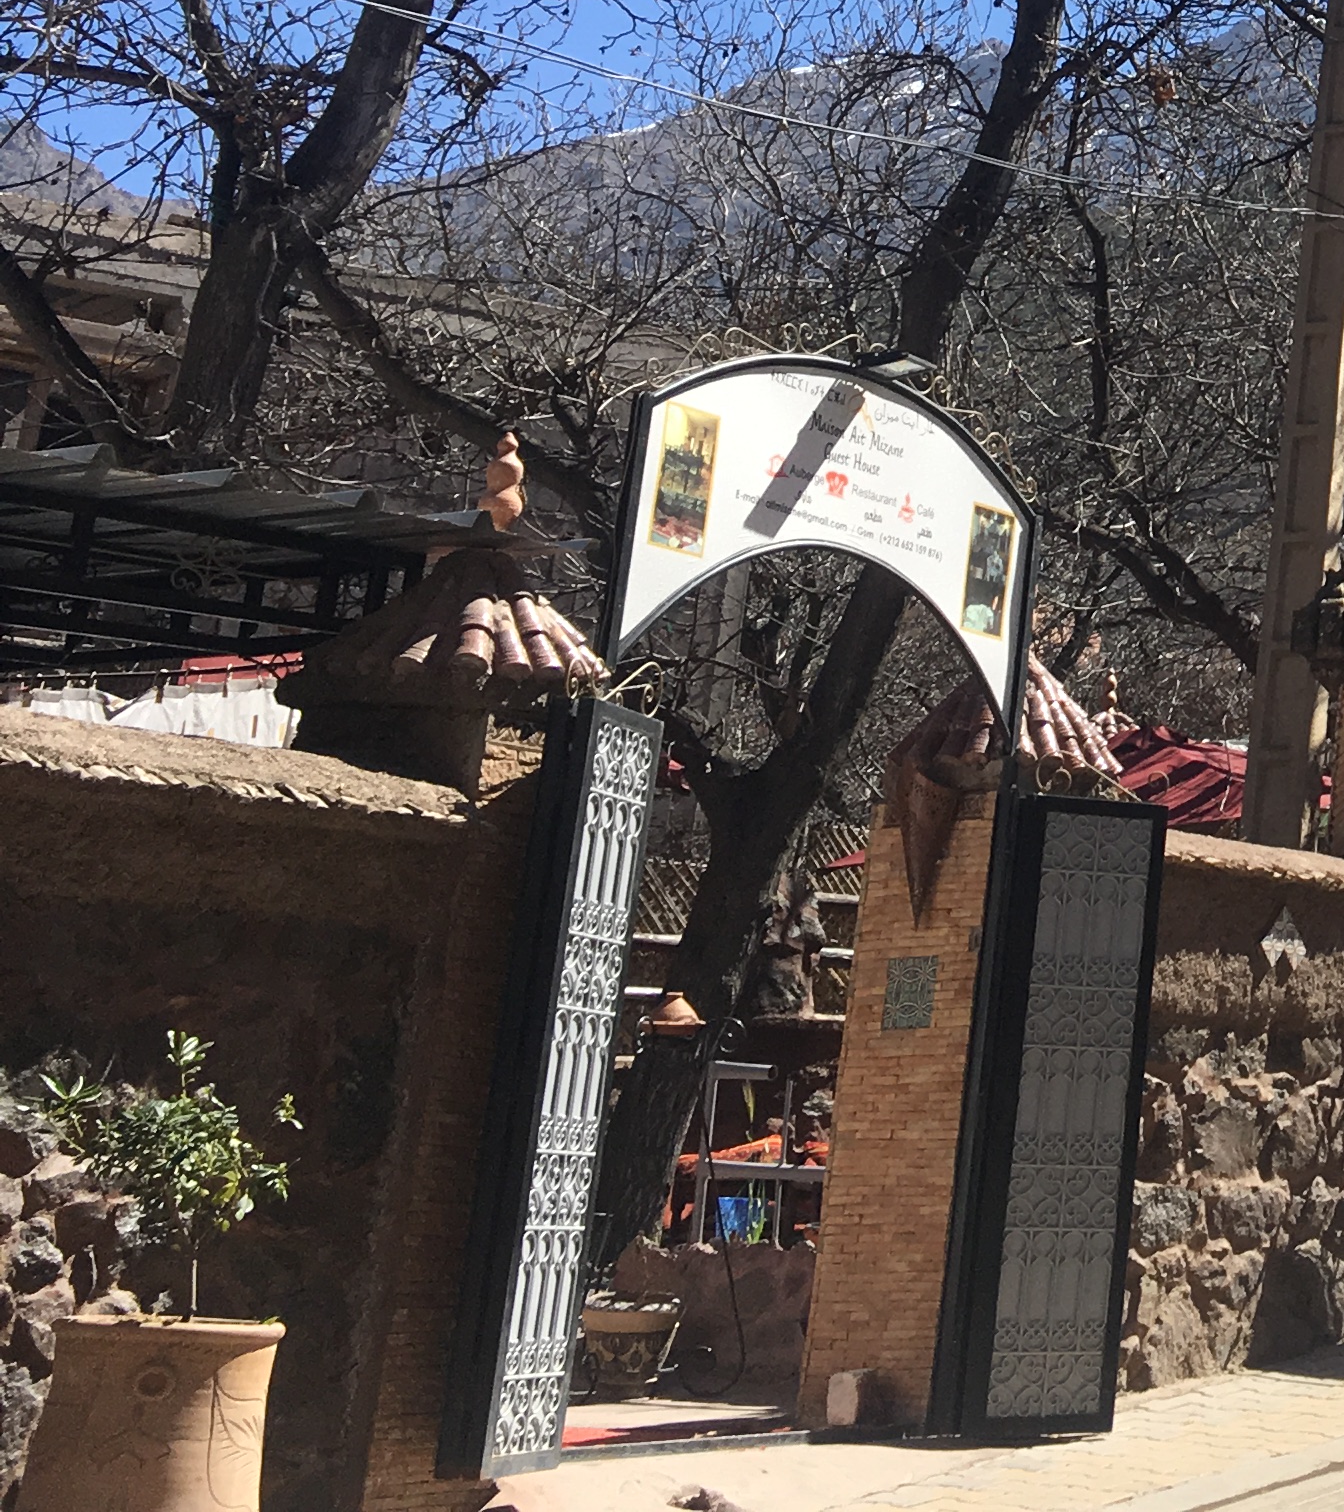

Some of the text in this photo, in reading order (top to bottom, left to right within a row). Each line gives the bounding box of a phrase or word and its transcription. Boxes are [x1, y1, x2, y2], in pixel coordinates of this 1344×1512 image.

[809, 410, 846, 439] Maison
[869, 430, 905, 459] Mizane
[823, 441, 881, 477] Guest House
[789, 464, 935, 520] Auberge Restaurant Café
